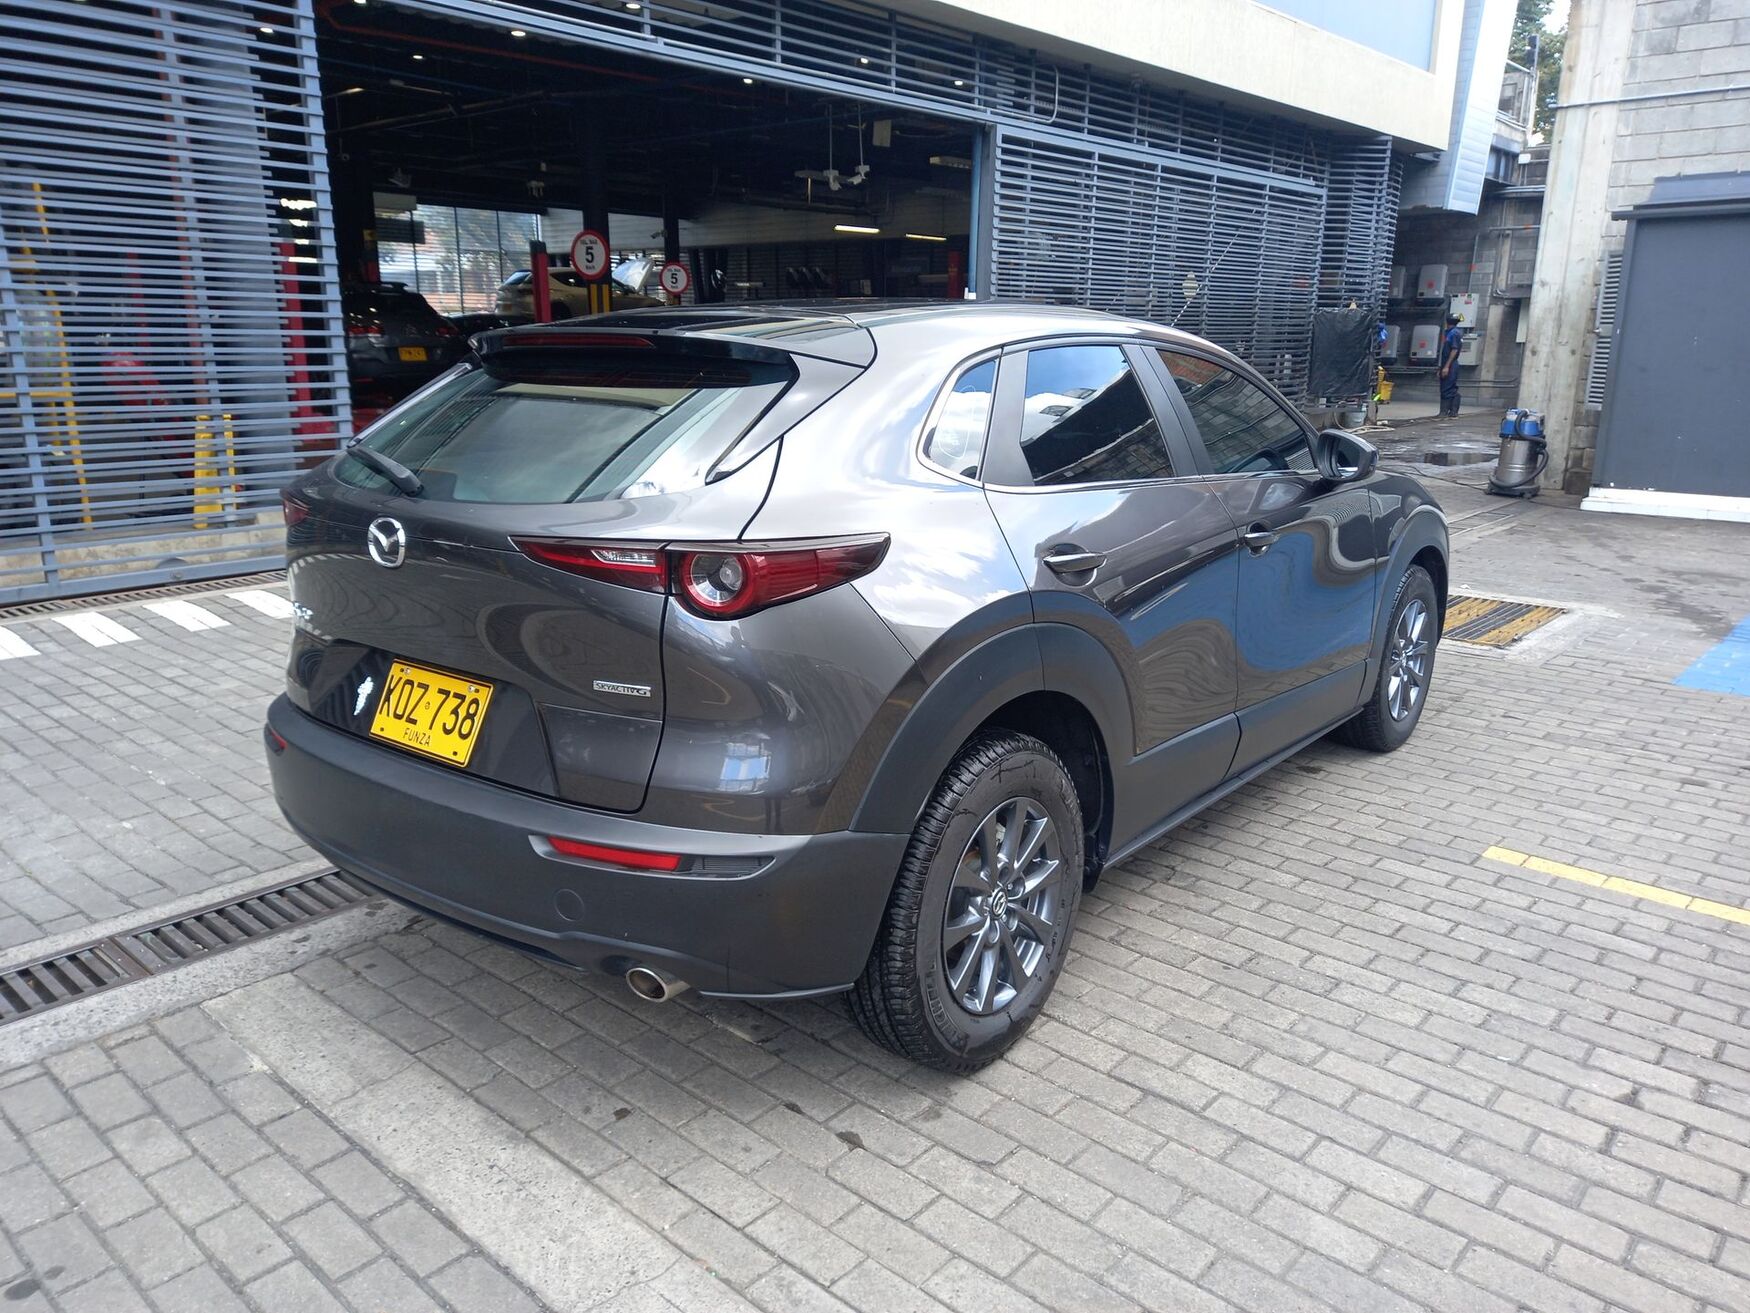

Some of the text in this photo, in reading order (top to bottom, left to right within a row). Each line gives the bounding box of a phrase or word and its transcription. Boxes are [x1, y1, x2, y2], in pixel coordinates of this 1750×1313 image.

[585, 246, 595, 263] 5
[670, 273, 678, 285] 5
[379, 674, 480, 740] KOZ 738
[403, 727, 432, 747] FUNZA
